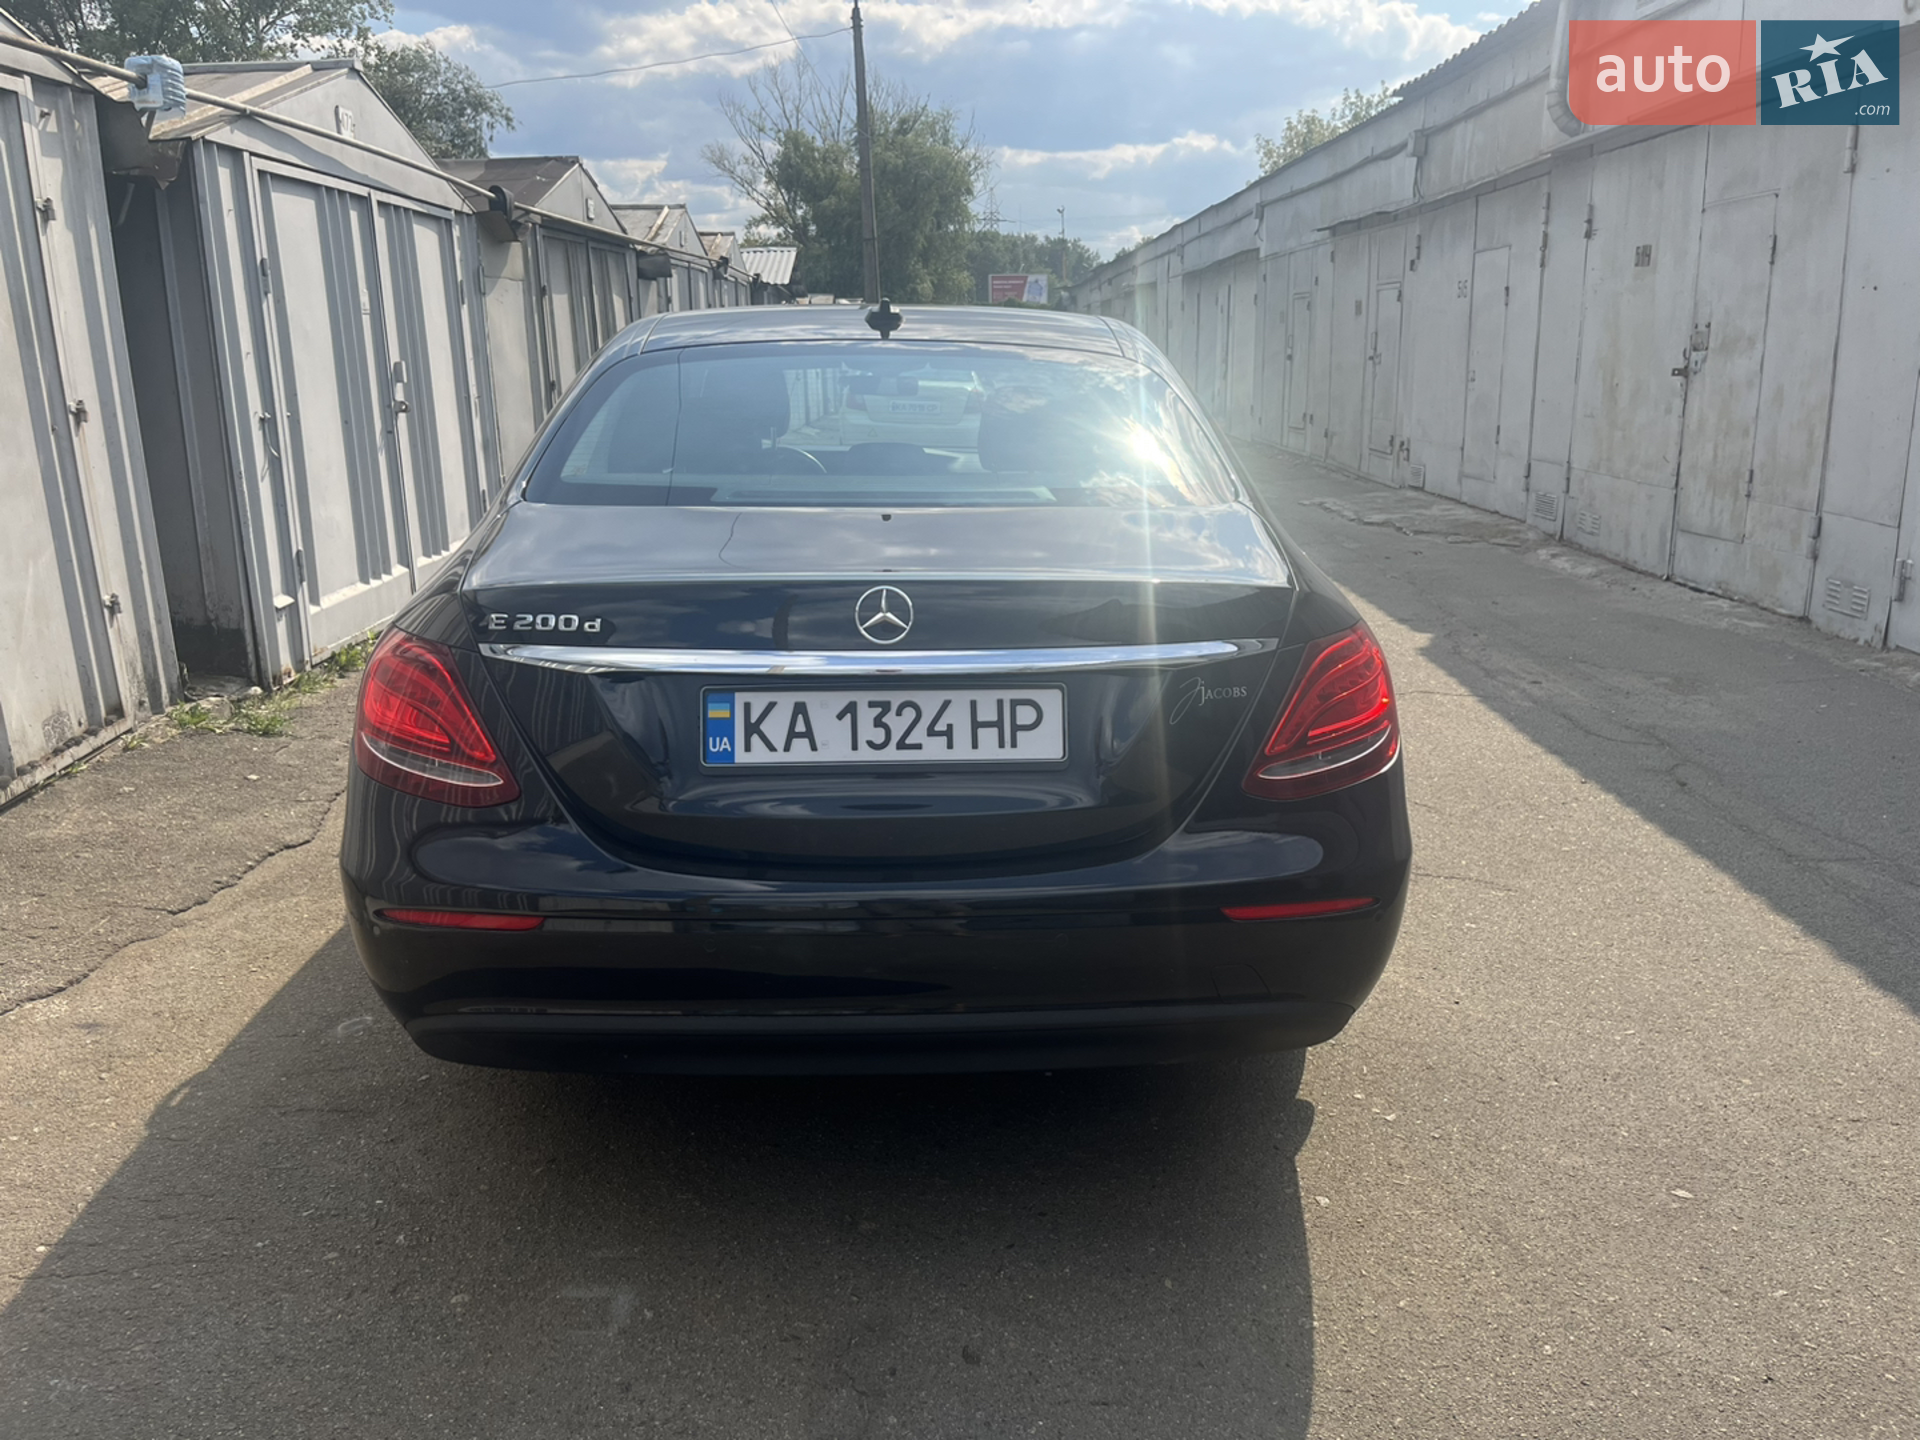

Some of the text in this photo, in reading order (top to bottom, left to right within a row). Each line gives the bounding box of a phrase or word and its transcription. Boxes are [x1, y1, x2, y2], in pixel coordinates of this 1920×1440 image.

[743, 698, 1044, 753] KA 1324 HP
[708, 736, 732, 753] UA
